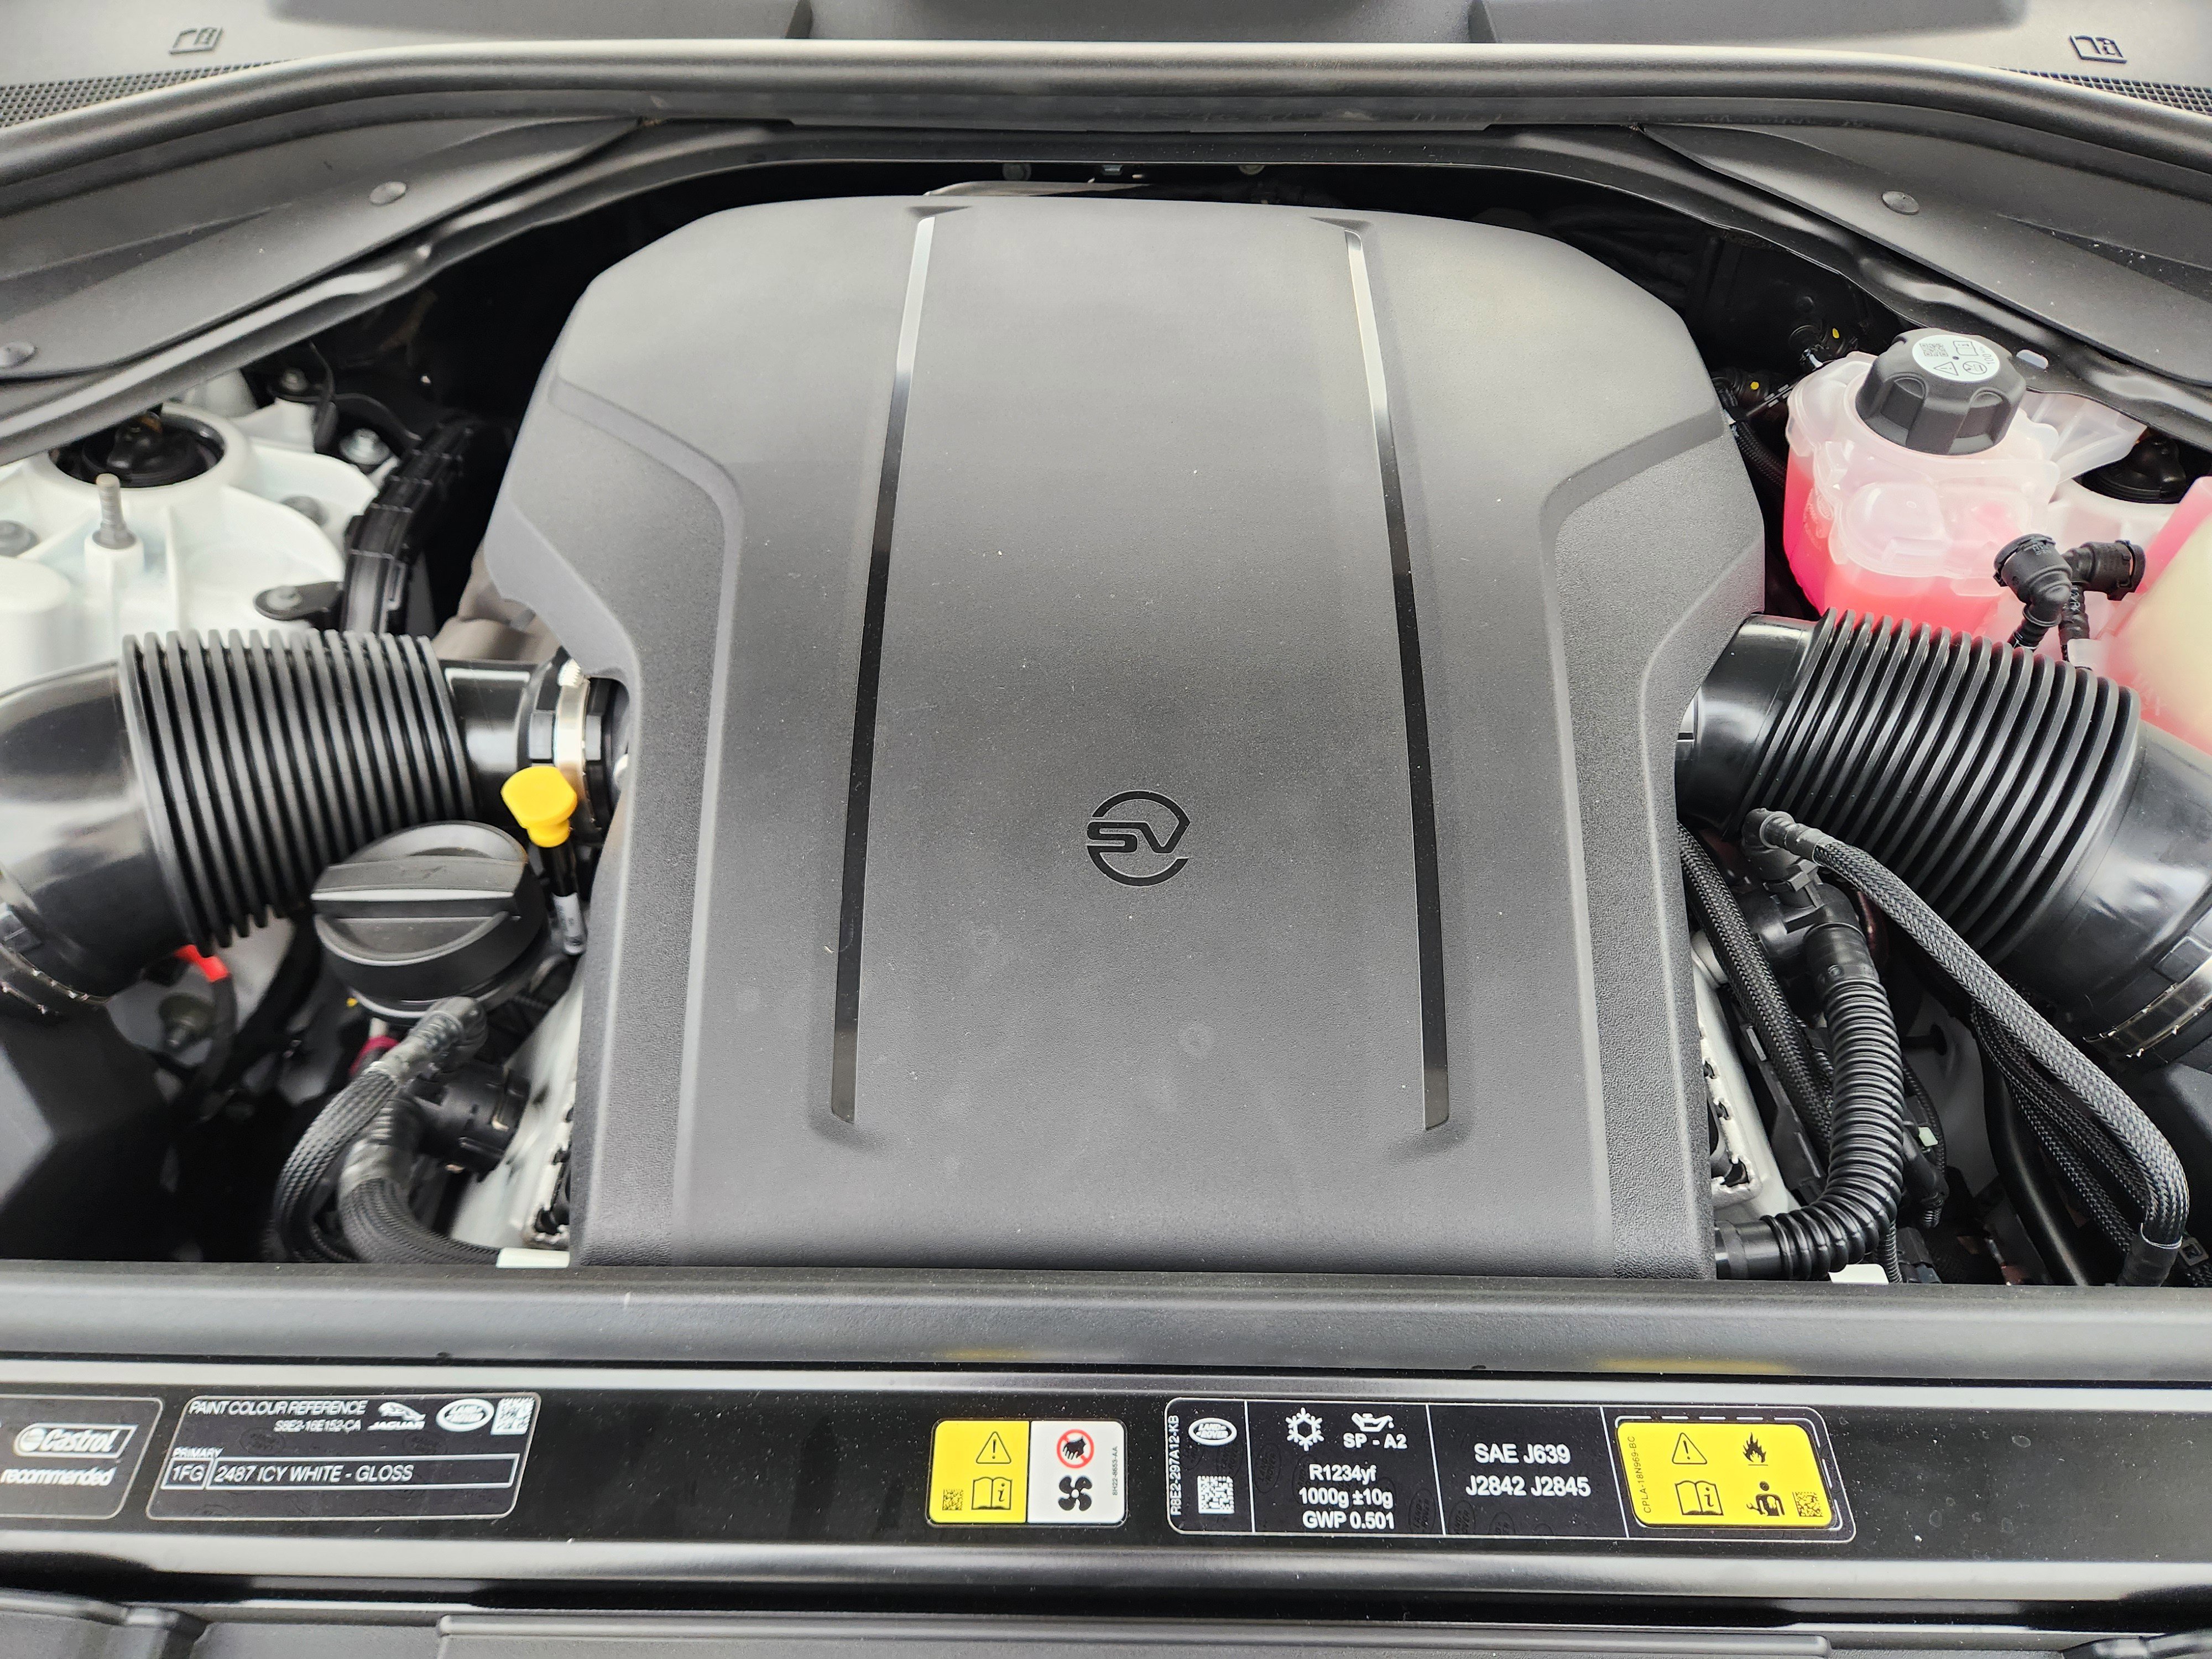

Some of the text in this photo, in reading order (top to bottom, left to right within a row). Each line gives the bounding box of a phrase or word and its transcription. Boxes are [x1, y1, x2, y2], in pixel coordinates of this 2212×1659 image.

[1982, 354, 1995, 364] 100
[189, 1400, 368, 1416] PAINT COLOUR REFERENCE
[367, 1421, 425, 1431] JAGUAR
[40, 1428, 121, 1453] Castrol
[1343, 1433, 1367, 1448] SP
[1384, 1433, 1408, 1449] A2
[172, 1447, 225, 1458] PRIMARY
[1474, 1443, 1571, 1464] SAE J639
[1, 1467, 117, 1486] recommended
[173, 1465, 205, 1481] 1FG
[214, 1465, 258, 1483] 2487
[256, 1465, 289, 1483] ICY
[289, 1465, 345, 1483] WHITE
[355, 1465, 414, 1482] GLOSS
[1309, 1464, 1377, 1485] R1234yf
[1627, 1436, 1651, 1514] CPLA-18N969-BC
[1466, 1475, 1592, 1497] J2842 J2845
[1299, 1486, 1394, 1510] 1000g ±10g
[1302, 1510, 1395, 1530] GWP 0.501
